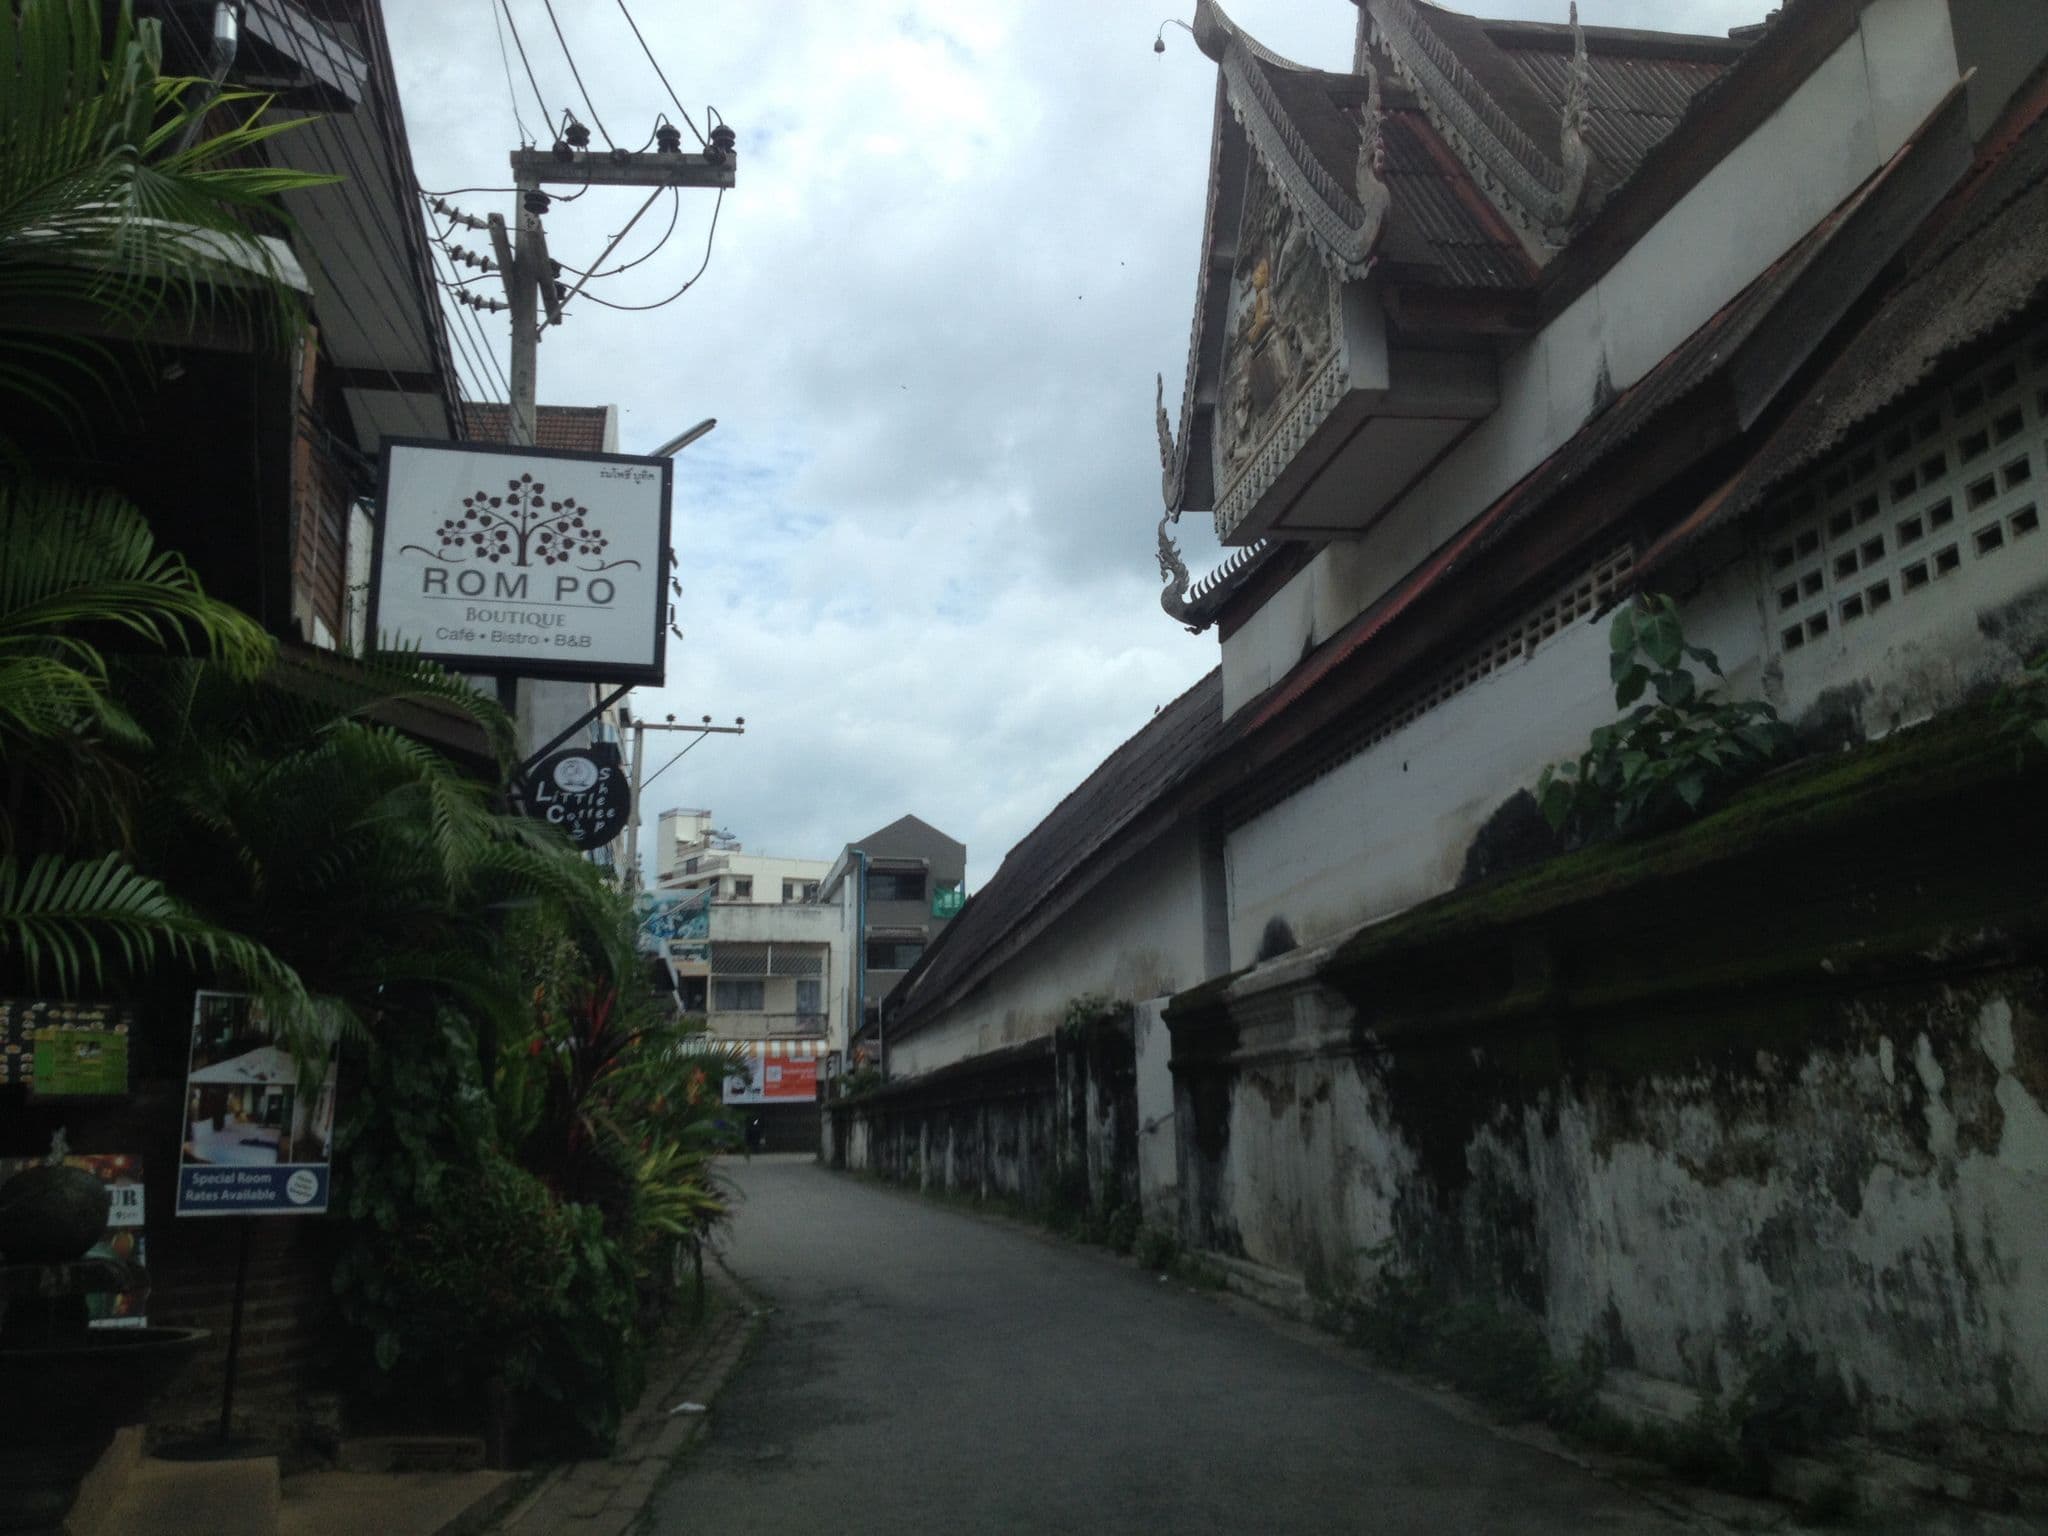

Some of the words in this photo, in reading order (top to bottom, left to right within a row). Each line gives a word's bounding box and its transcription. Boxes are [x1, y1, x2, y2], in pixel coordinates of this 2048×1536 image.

[422, 567, 528, 598] ROM
[554, 575, 616, 605] PO
[465, 606, 567, 629] BOUTIQUE
[435, 627, 475, 643] Café
[490, 629, 538, 646] Bistro
[554, 633, 592, 648] B&B
[192, 1172, 235, 1186] Special
[237, 1172, 272, 1184] Room
[185, 1189, 219, 1201] Rates
[220, 1189, 277, 1201] Available
